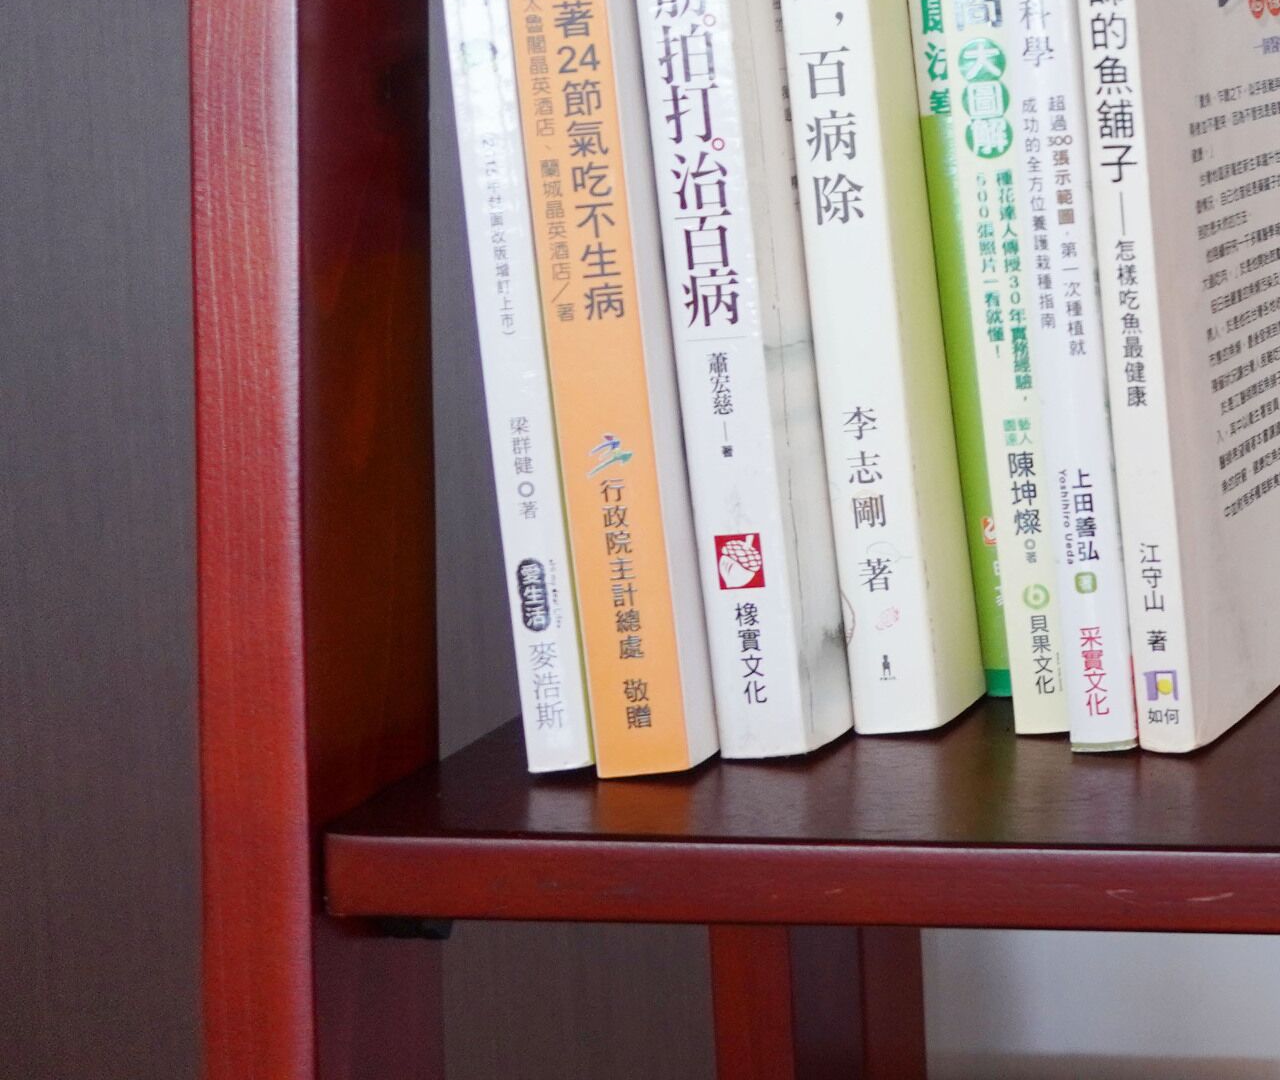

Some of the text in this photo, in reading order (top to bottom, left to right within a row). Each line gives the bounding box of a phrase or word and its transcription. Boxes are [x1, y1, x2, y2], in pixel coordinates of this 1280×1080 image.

[843, 406, 894, 593] 李志剛 著
[1008, 450, 1042, 536] 陳坤燦
[1072, 468, 1100, 562] 上田善弘
[1063, 533, 1075, 565] Ueda
[601, 478, 653, 729] 行政院主計總處 敬贈
[1139, 542, 1168, 653] 江守山 著
[529, 641, 565, 730] 麥浩斯
[734, 602, 768, 705] 橡實文化
[1030, 614, 1056, 695] 貝果文化
[1079, 626, 1111, 717] 采實文化
[1148, 708, 1180, 726] 如何
